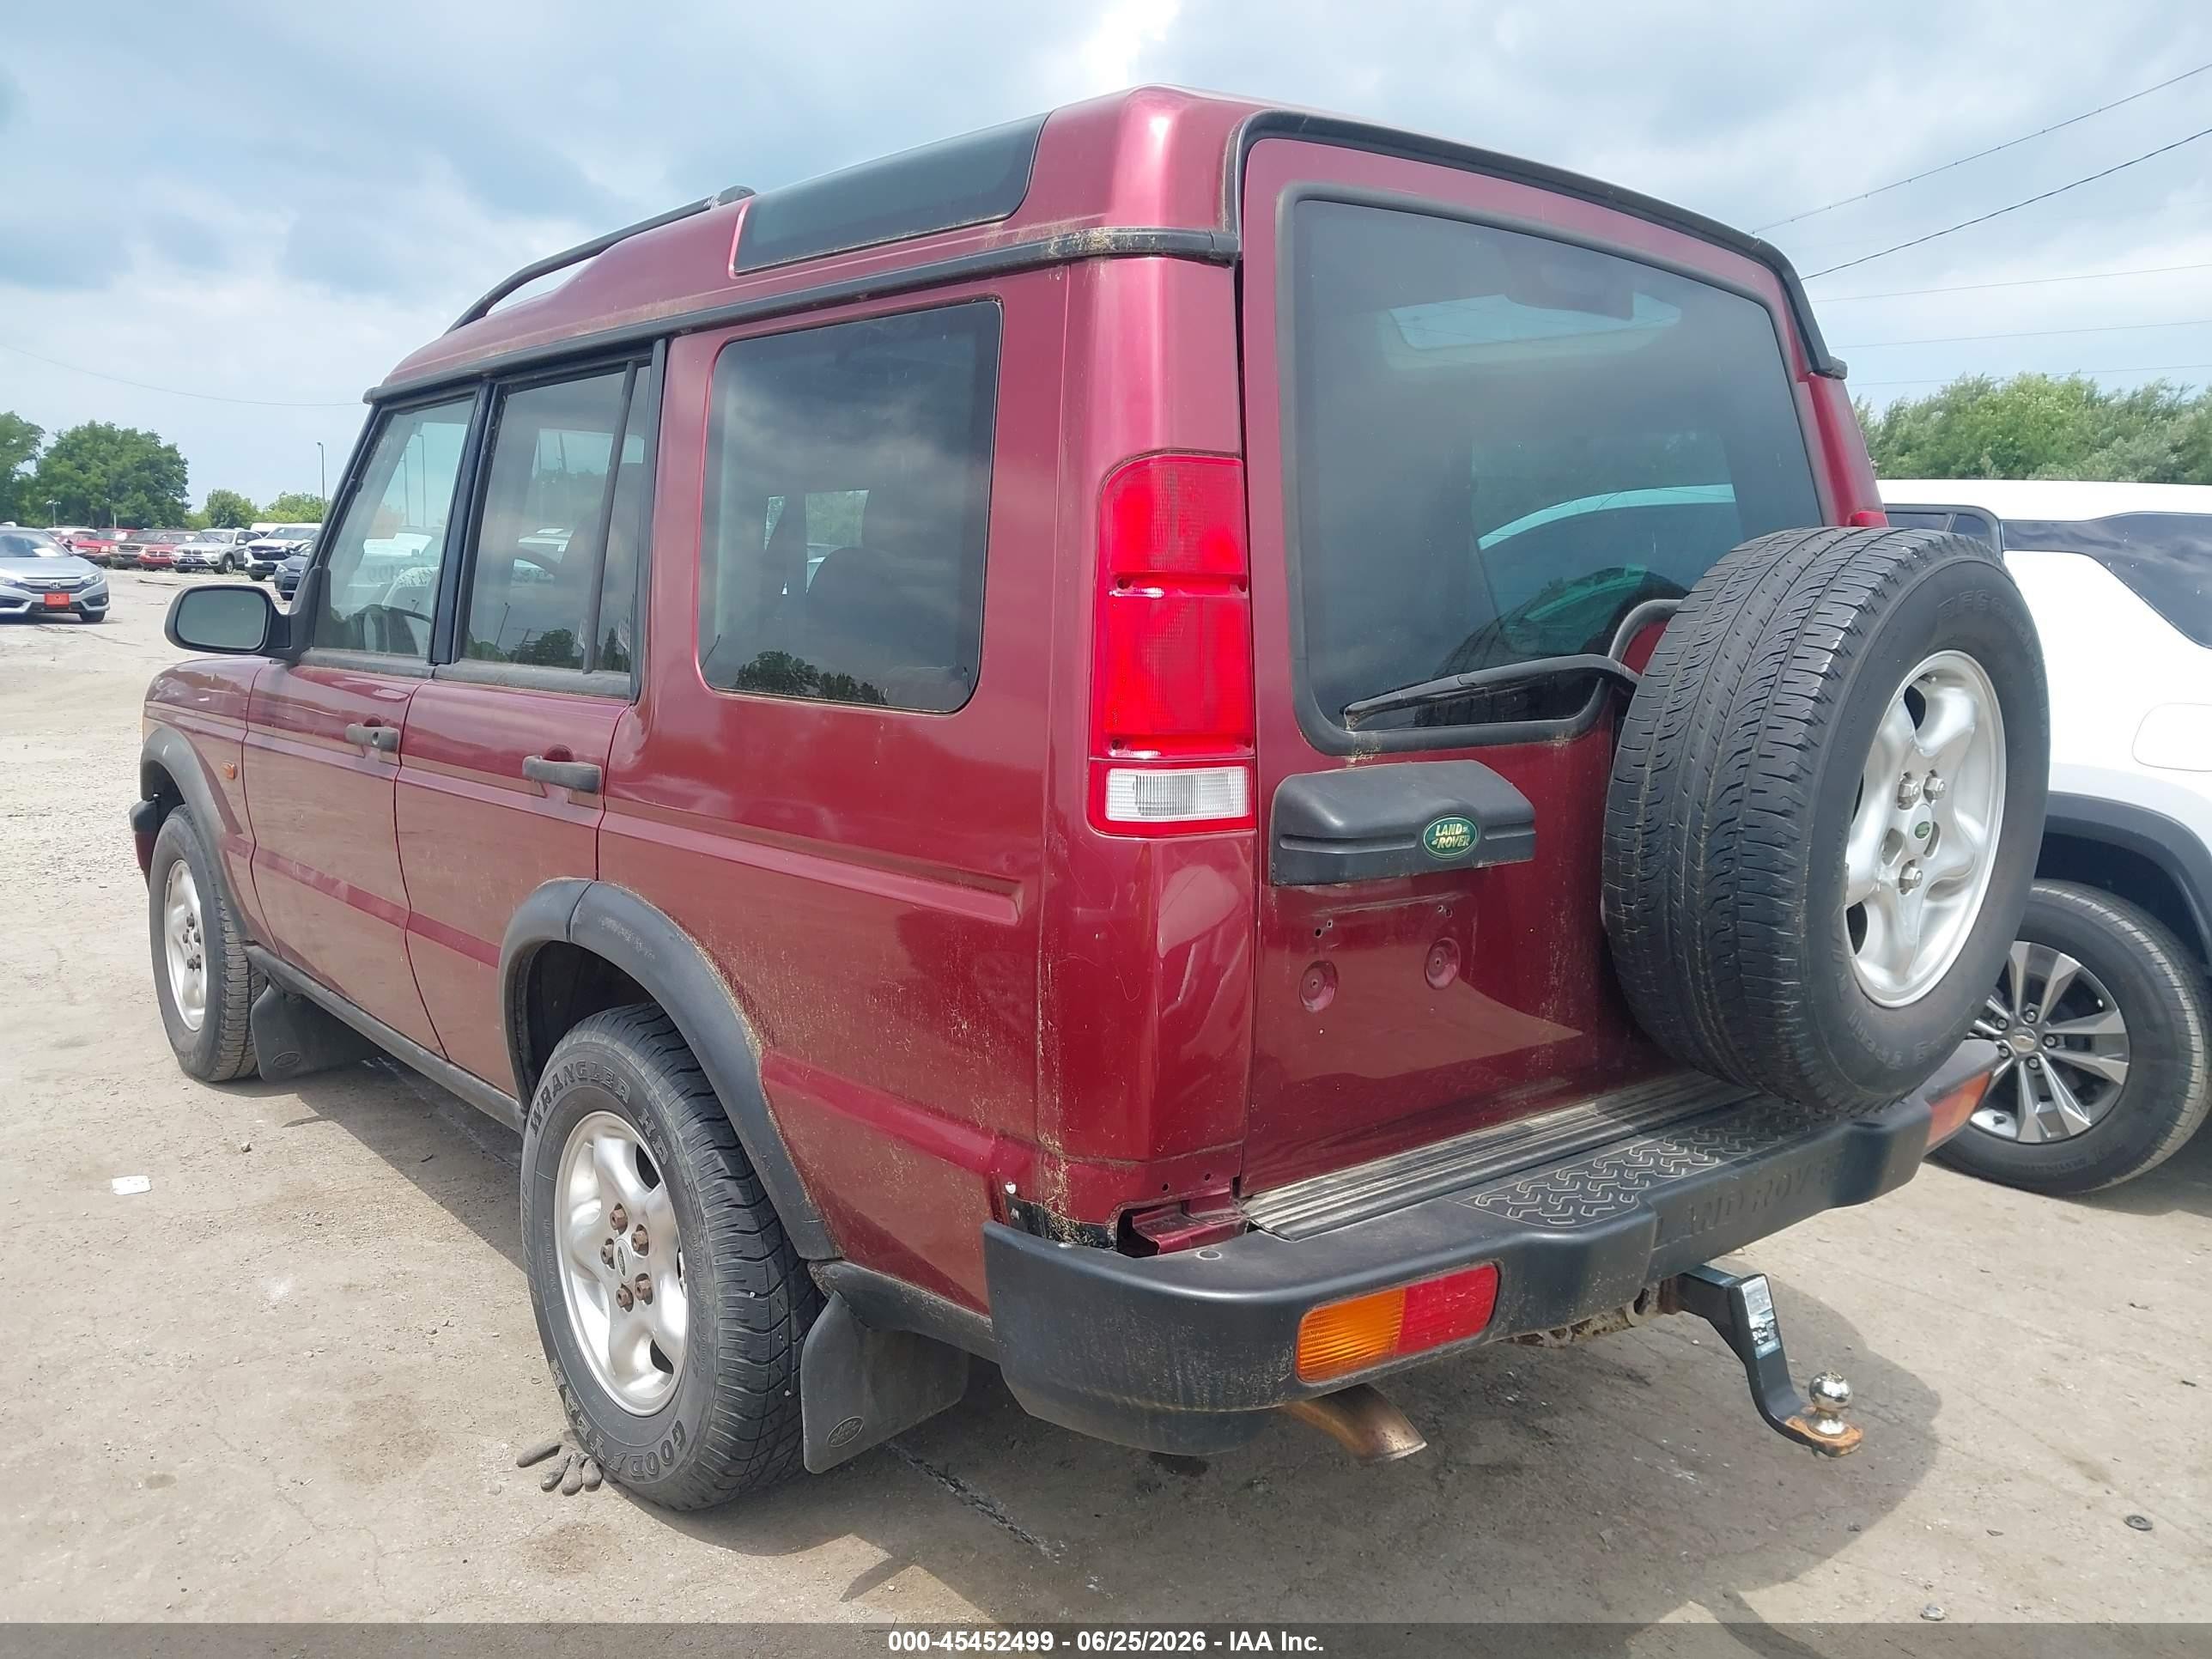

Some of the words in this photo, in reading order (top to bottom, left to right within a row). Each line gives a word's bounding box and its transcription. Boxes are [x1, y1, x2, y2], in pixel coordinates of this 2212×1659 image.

[1435, 823, 1462, 836] LAND
[1437, 835, 1470, 848] ROVER
[529, 1059, 632, 1138] WRANGLER
[637, 1108, 669, 1165] HP
[550, 1357, 686, 1479] GOODYEAR
